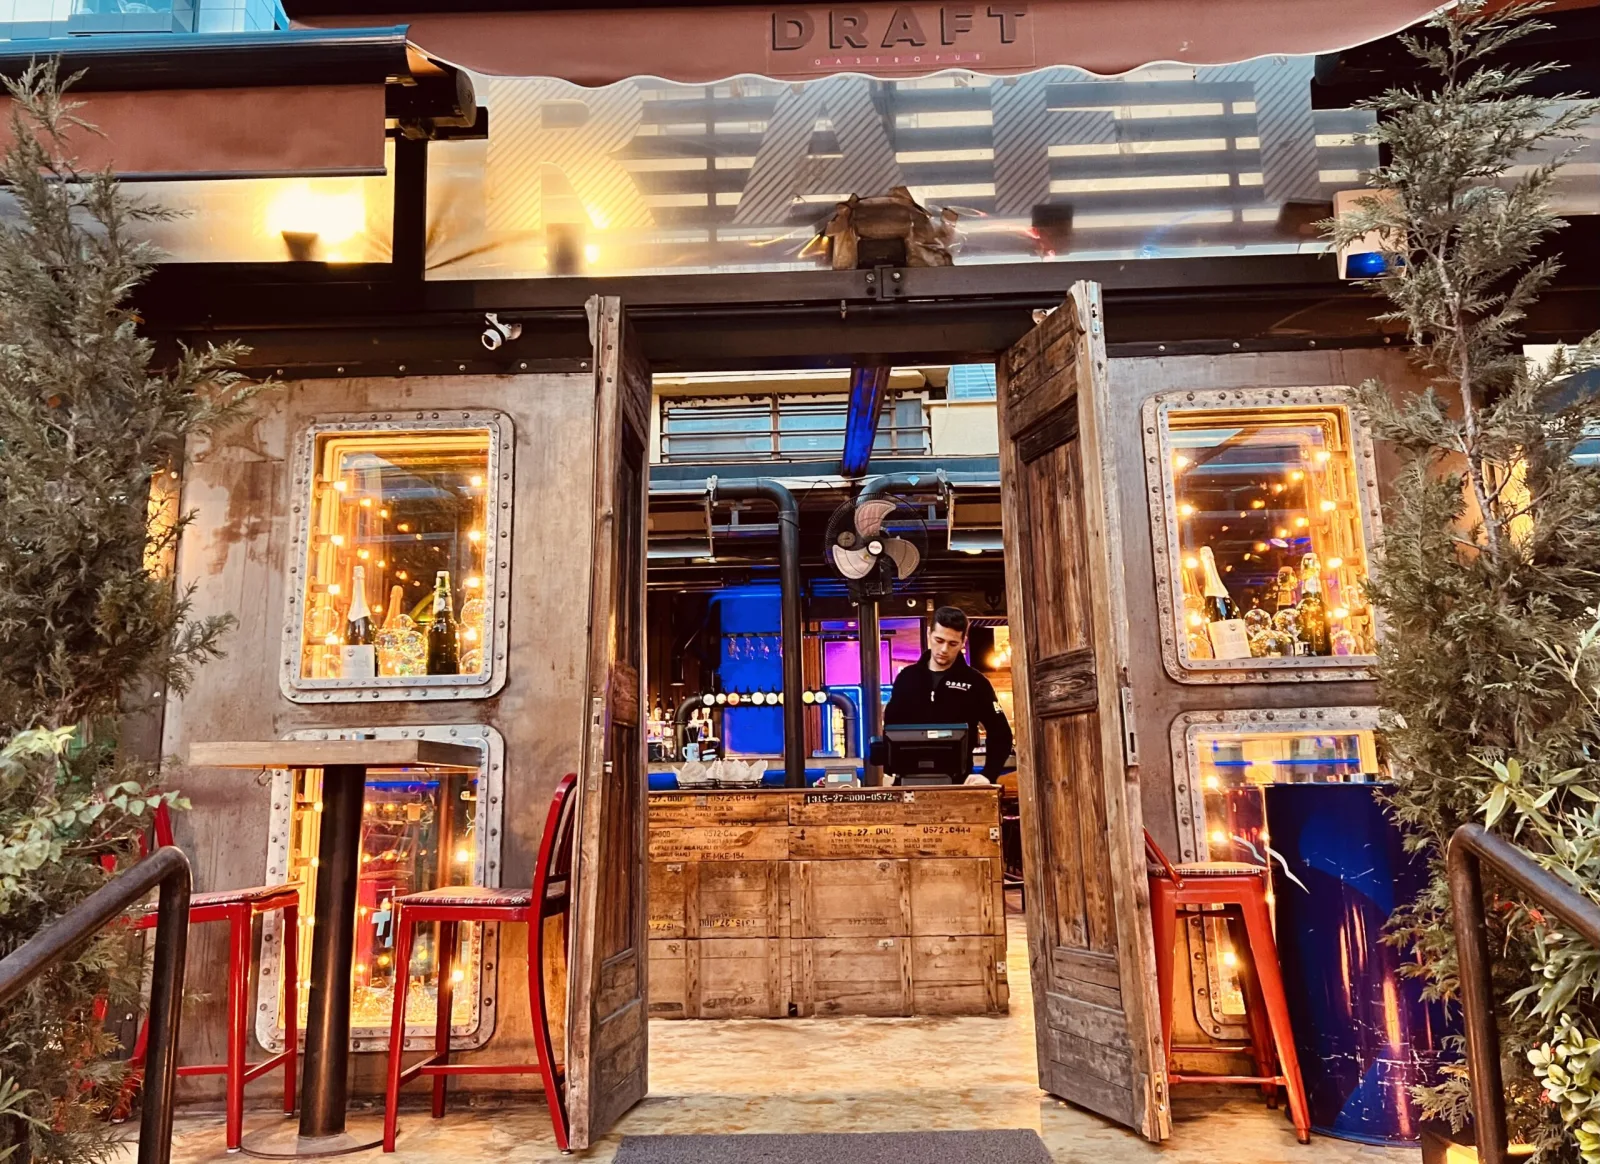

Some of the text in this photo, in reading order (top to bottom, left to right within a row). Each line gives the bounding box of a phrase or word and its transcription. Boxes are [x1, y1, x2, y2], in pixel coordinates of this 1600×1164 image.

[771, 5, 1027, 51] DRAFT
[814, 53, 981, 66] GASTROPUB
[945, 680, 972, 690] DRAFT
